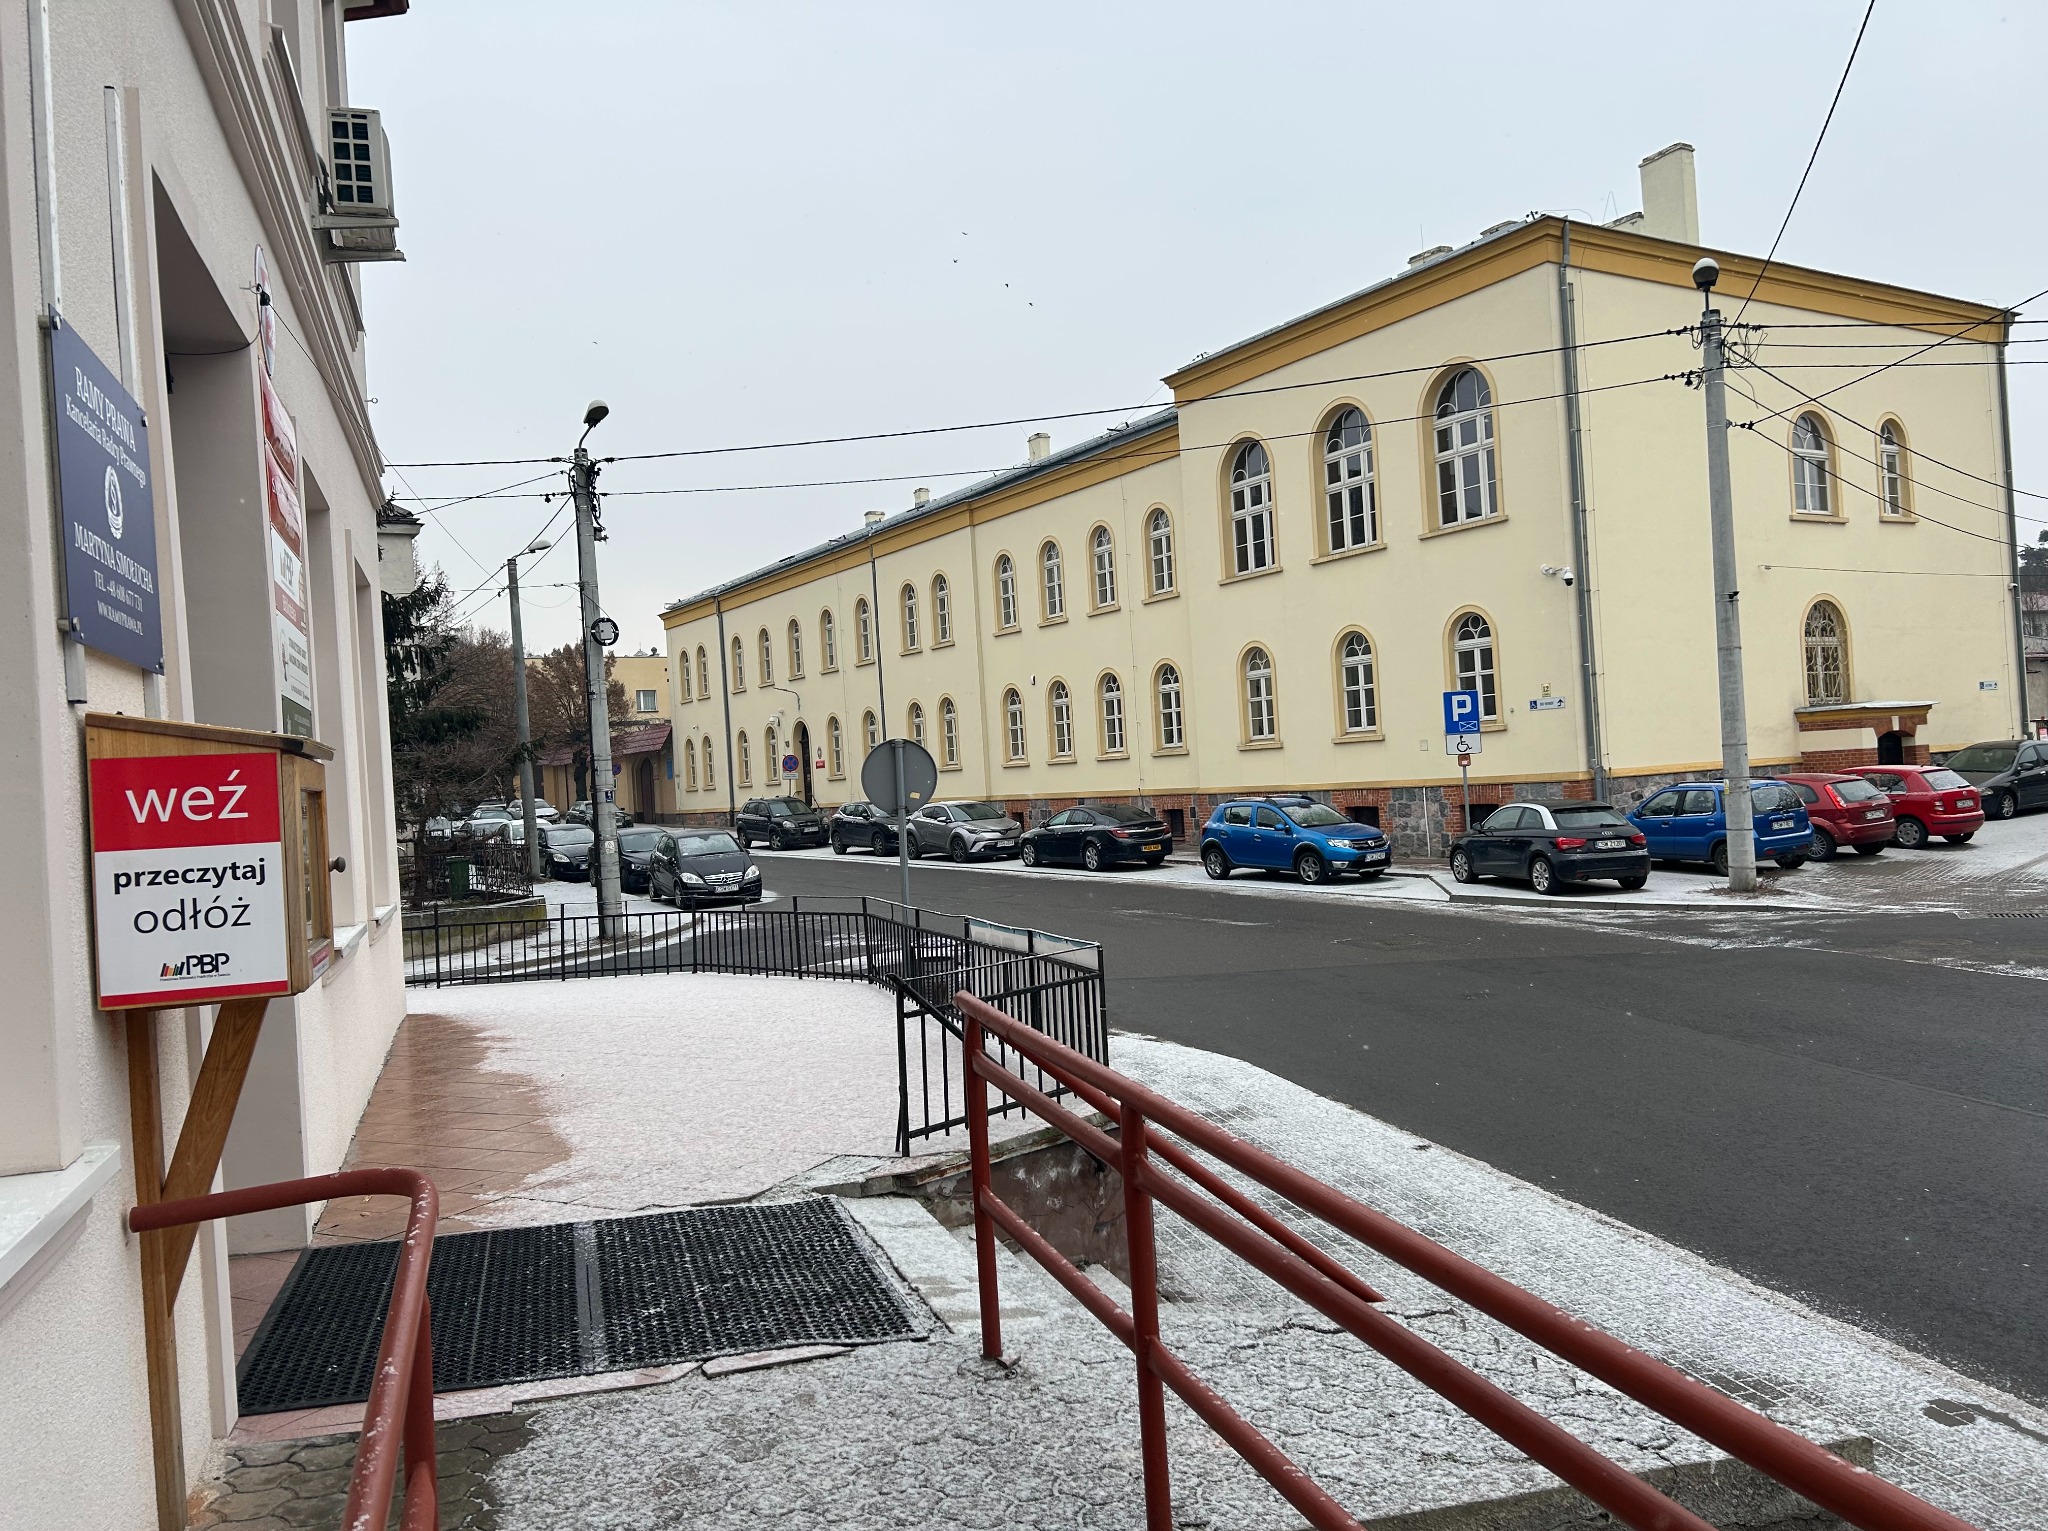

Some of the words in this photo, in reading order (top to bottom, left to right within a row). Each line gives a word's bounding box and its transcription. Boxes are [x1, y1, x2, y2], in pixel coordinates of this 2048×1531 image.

[75, 366, 104, 420] RAMY
[105, 397, 136, 452] PRAWA
[65, 393, 102, 445] Kancelaria
[102, 428, 119, 466] Radcy
[119, 445, 146, 488] Prawnego
[74, 521, 116, 571] MARTYNA
[116, 550, 154, 594] SMOŁUCHA
[1451, 694, 1472, 722] P
[125, 769, 249, 824] weź
[113, 857, 266, 895] przeczytaj
[133, 895, 252, 934] odłóż
[185, 952, 230, 976] PBP
